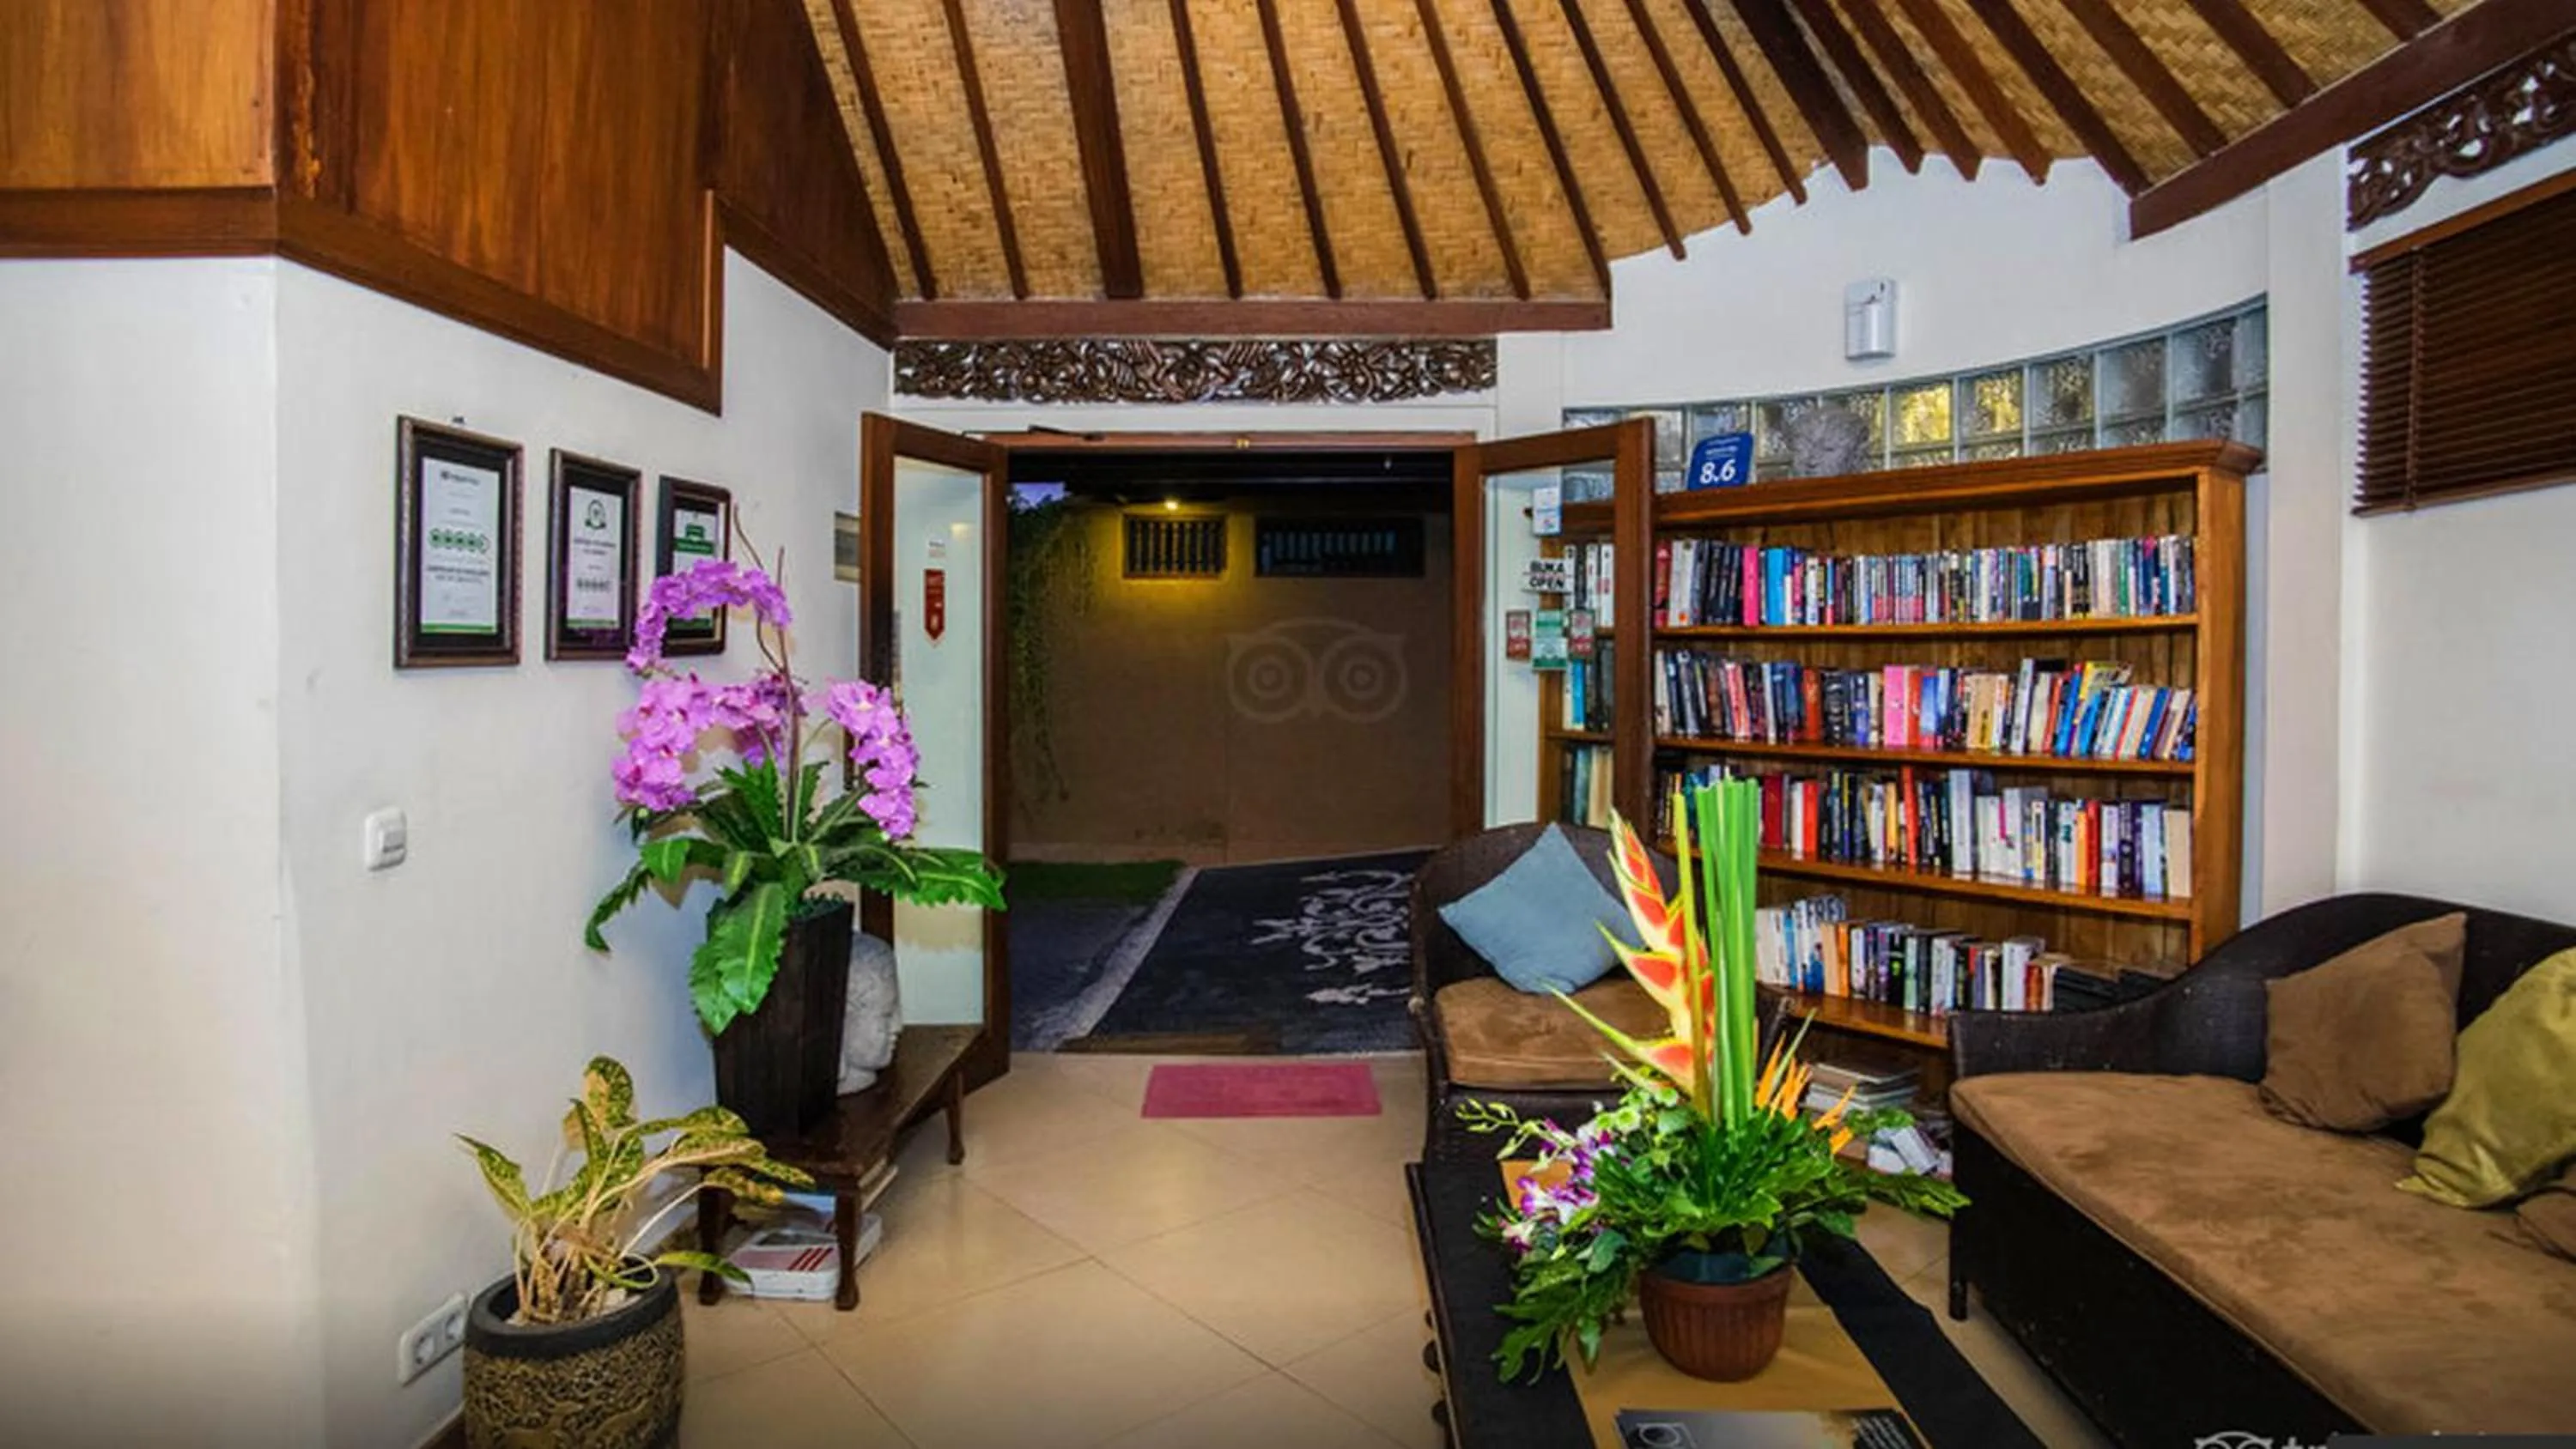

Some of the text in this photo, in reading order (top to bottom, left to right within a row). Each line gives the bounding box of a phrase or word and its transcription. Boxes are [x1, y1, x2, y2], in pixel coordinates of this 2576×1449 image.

[1700, 458, 1736, 484] 8.6
[1529, 561, 1564, 573] BUKA
[1529, 576, 1564, 589] OPEN
